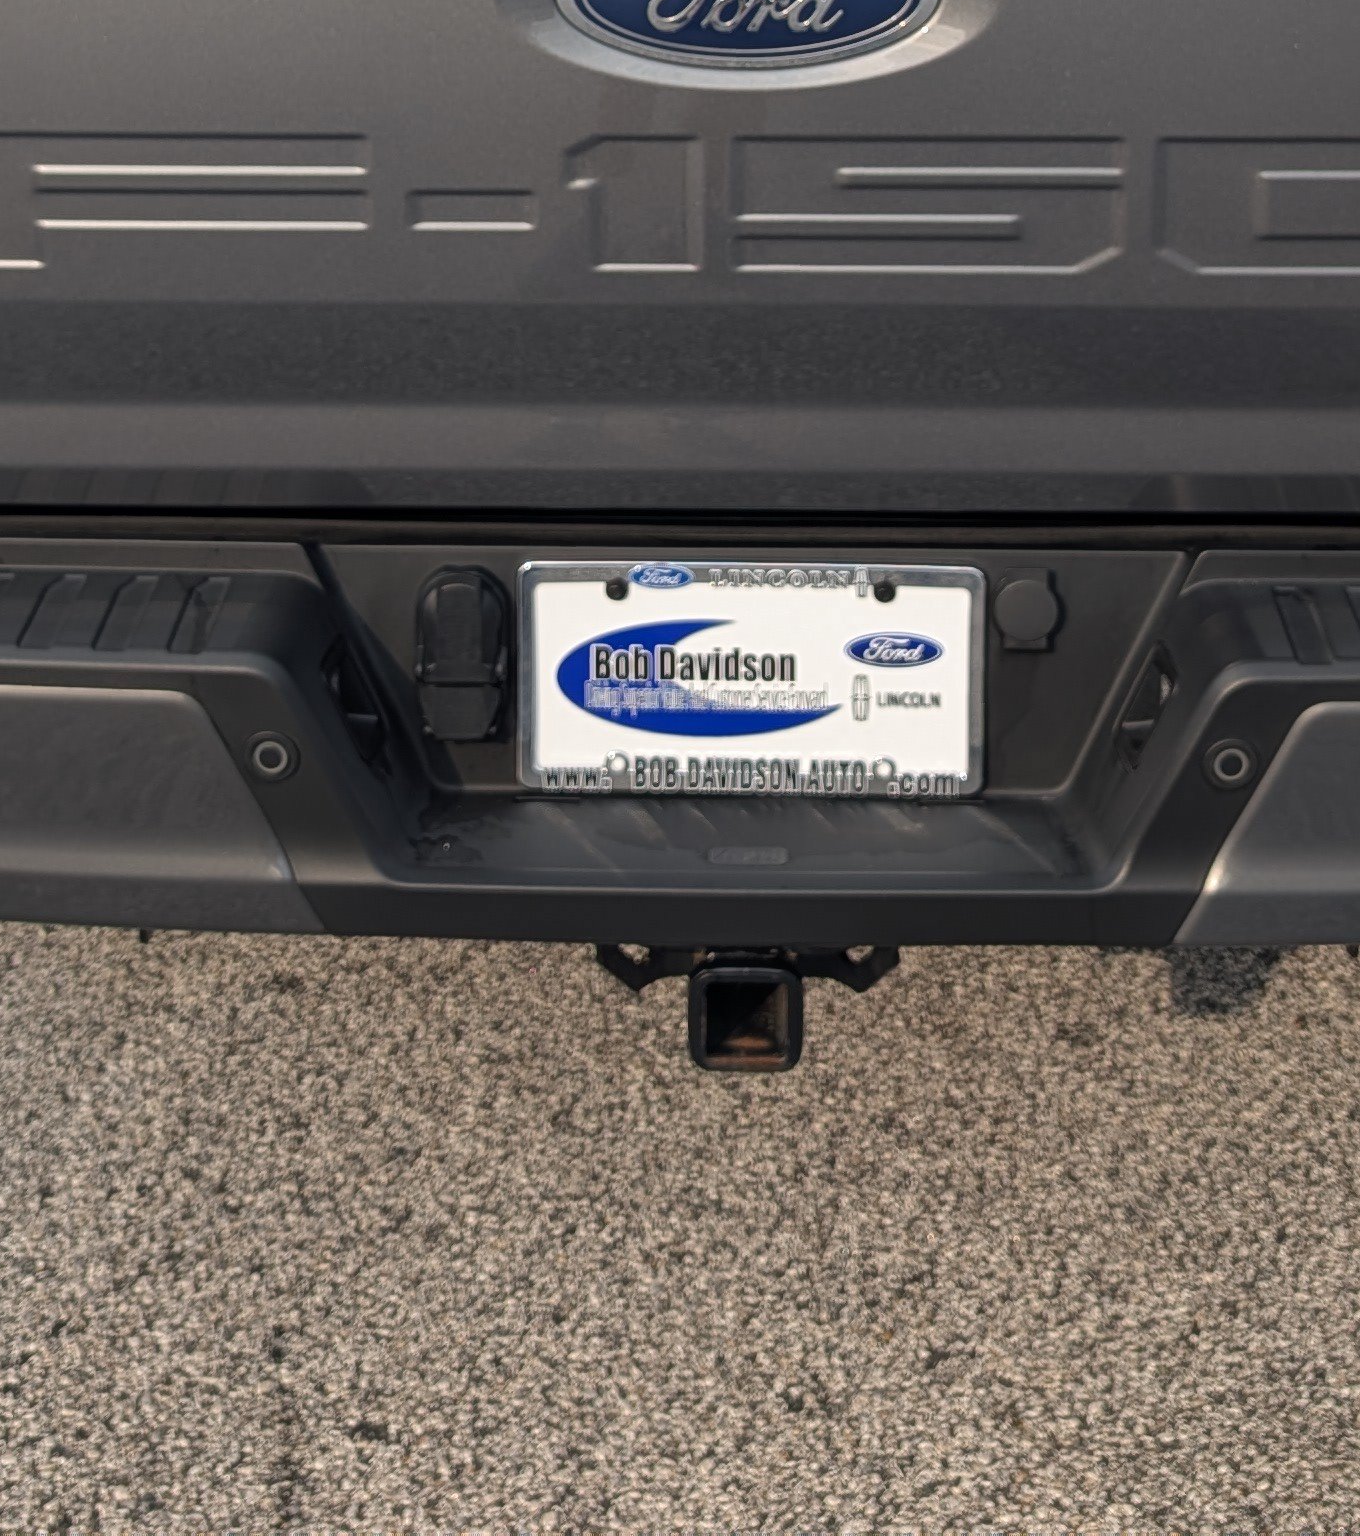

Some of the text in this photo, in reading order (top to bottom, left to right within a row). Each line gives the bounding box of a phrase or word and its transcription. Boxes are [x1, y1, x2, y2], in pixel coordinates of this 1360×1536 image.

[708, 568, 851, 588] LINCOLN
[593, 645, 797, 681] Bob Davidson
[861, 638, 927, 663] Ford
[876, 692, 942, 708] LINCOLN
[634, 756, 678, 791] BOB
[687, 756, 800, 793] DAVIDSON
[806, 758, 868, 794] AUTO
